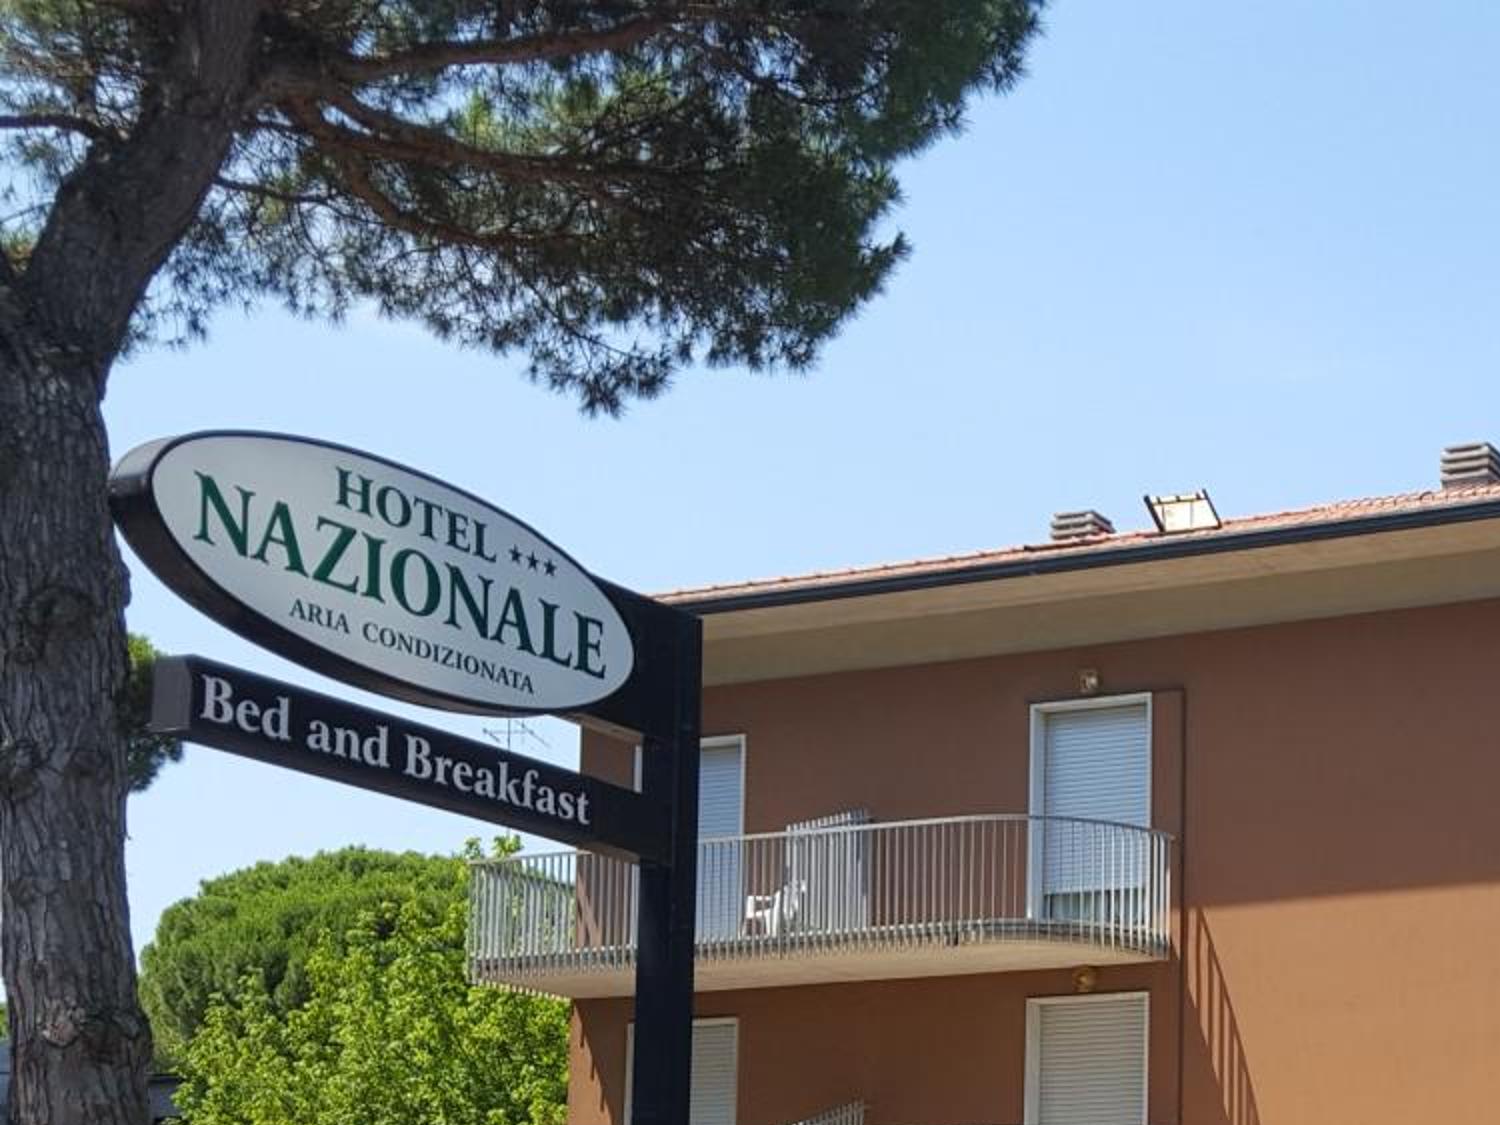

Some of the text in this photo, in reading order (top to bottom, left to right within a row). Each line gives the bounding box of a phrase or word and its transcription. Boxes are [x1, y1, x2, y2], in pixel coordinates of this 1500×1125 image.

[193, 470, 607, 681] NAZIONALE
[335, 466, 497, 564] HOTEL
[288, 598, 535, 696] ARIA CONDIZIONATA
[200, 675, 590, 825] Bed and Breakfast
